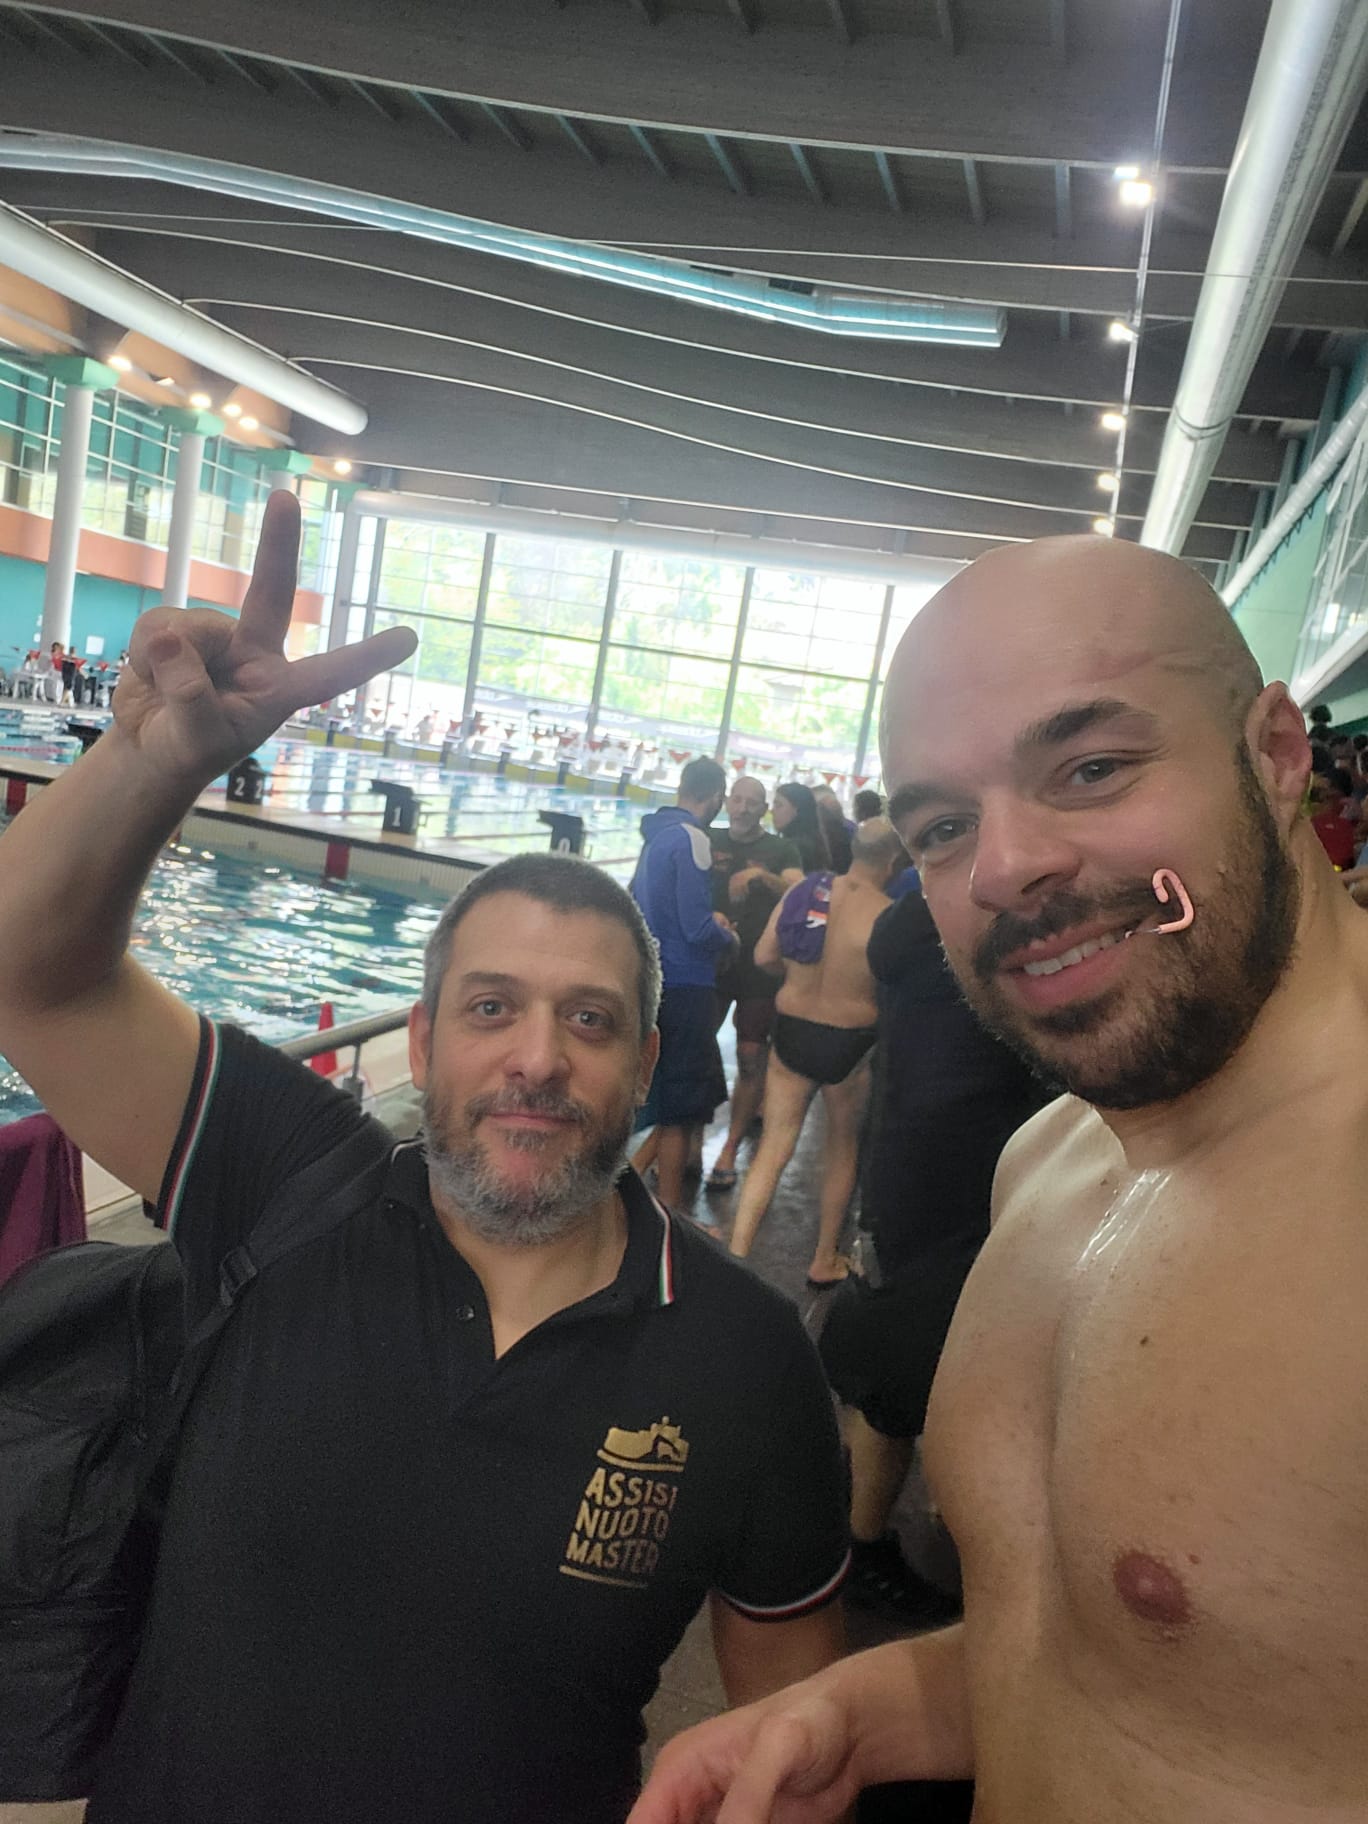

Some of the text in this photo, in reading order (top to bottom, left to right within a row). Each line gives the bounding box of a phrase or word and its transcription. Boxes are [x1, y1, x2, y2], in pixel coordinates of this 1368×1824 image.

[234, 775, 245, 796] 2
[391, 806, 402, 827] 1
[585, 1467, 679, 1511] ASSISI
[575, 1499, 670, 1541] NUOTO
